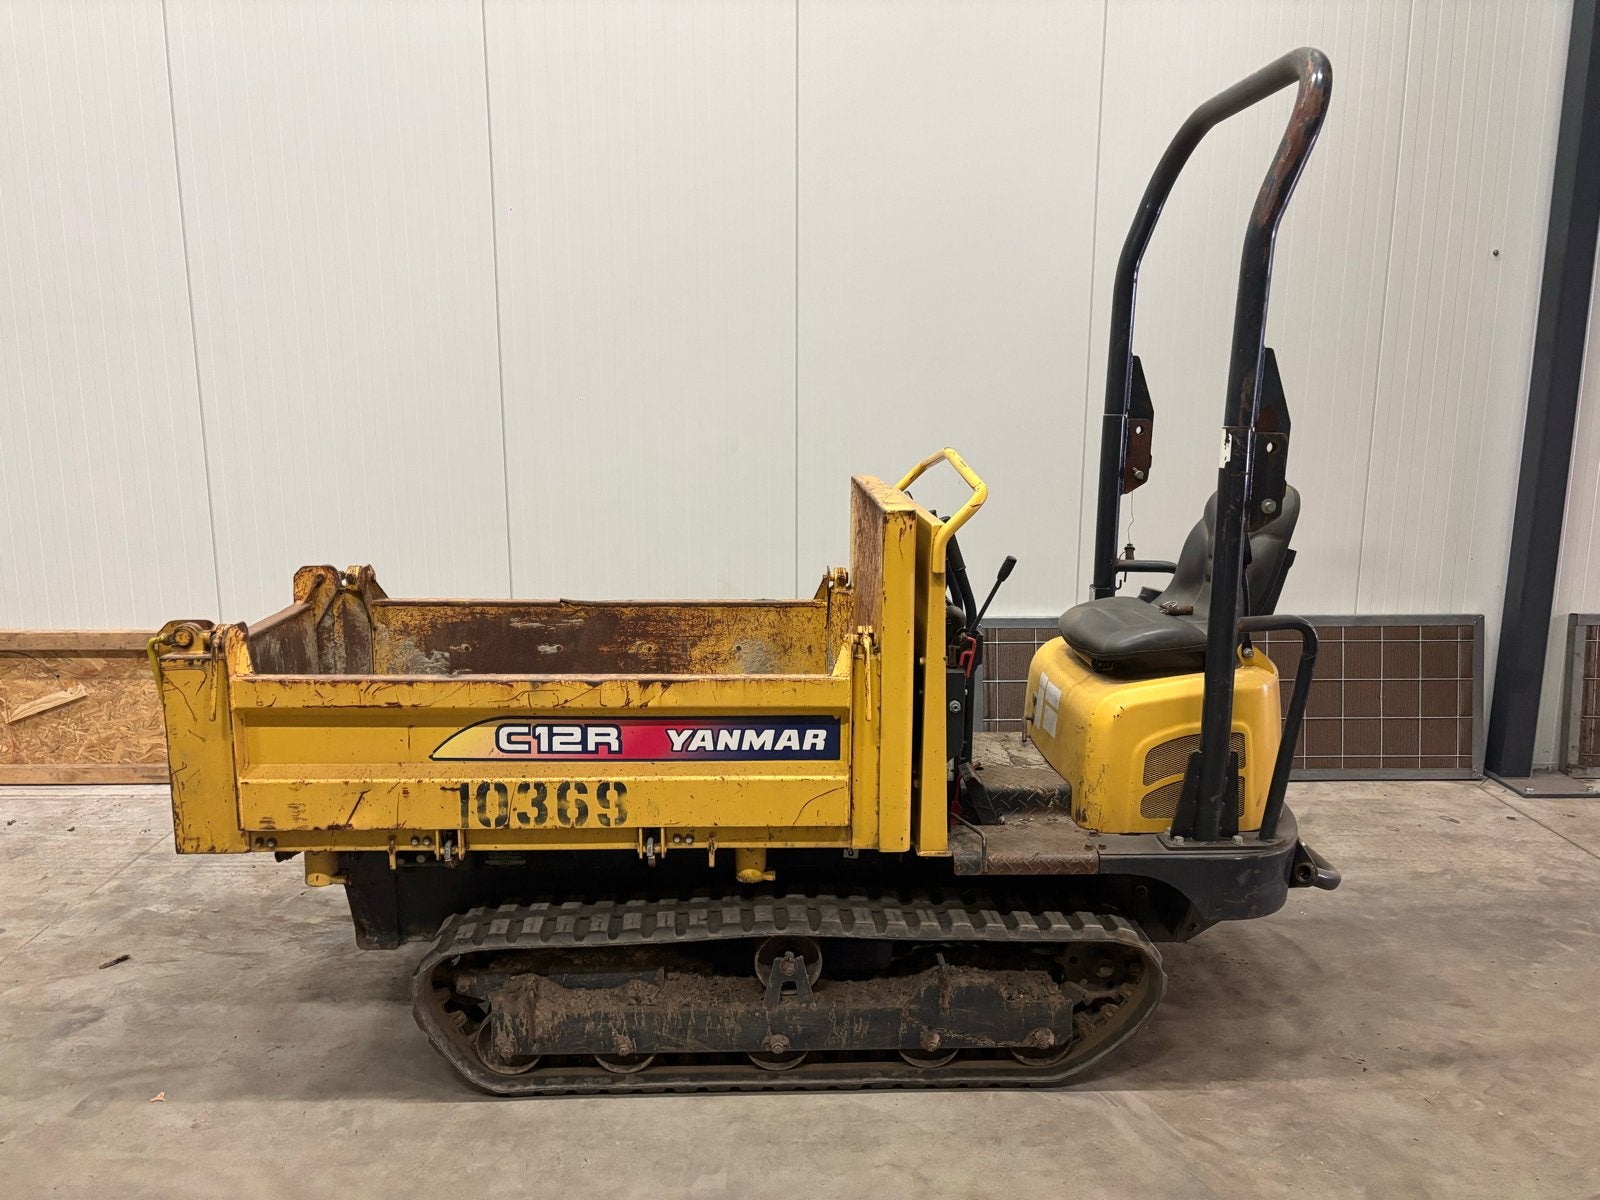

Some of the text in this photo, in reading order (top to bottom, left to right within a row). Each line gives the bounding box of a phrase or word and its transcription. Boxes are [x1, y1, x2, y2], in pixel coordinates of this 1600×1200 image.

[495, 724, 828, 755] C12R YANMAR
[460, 781, 628, 828] 10369
